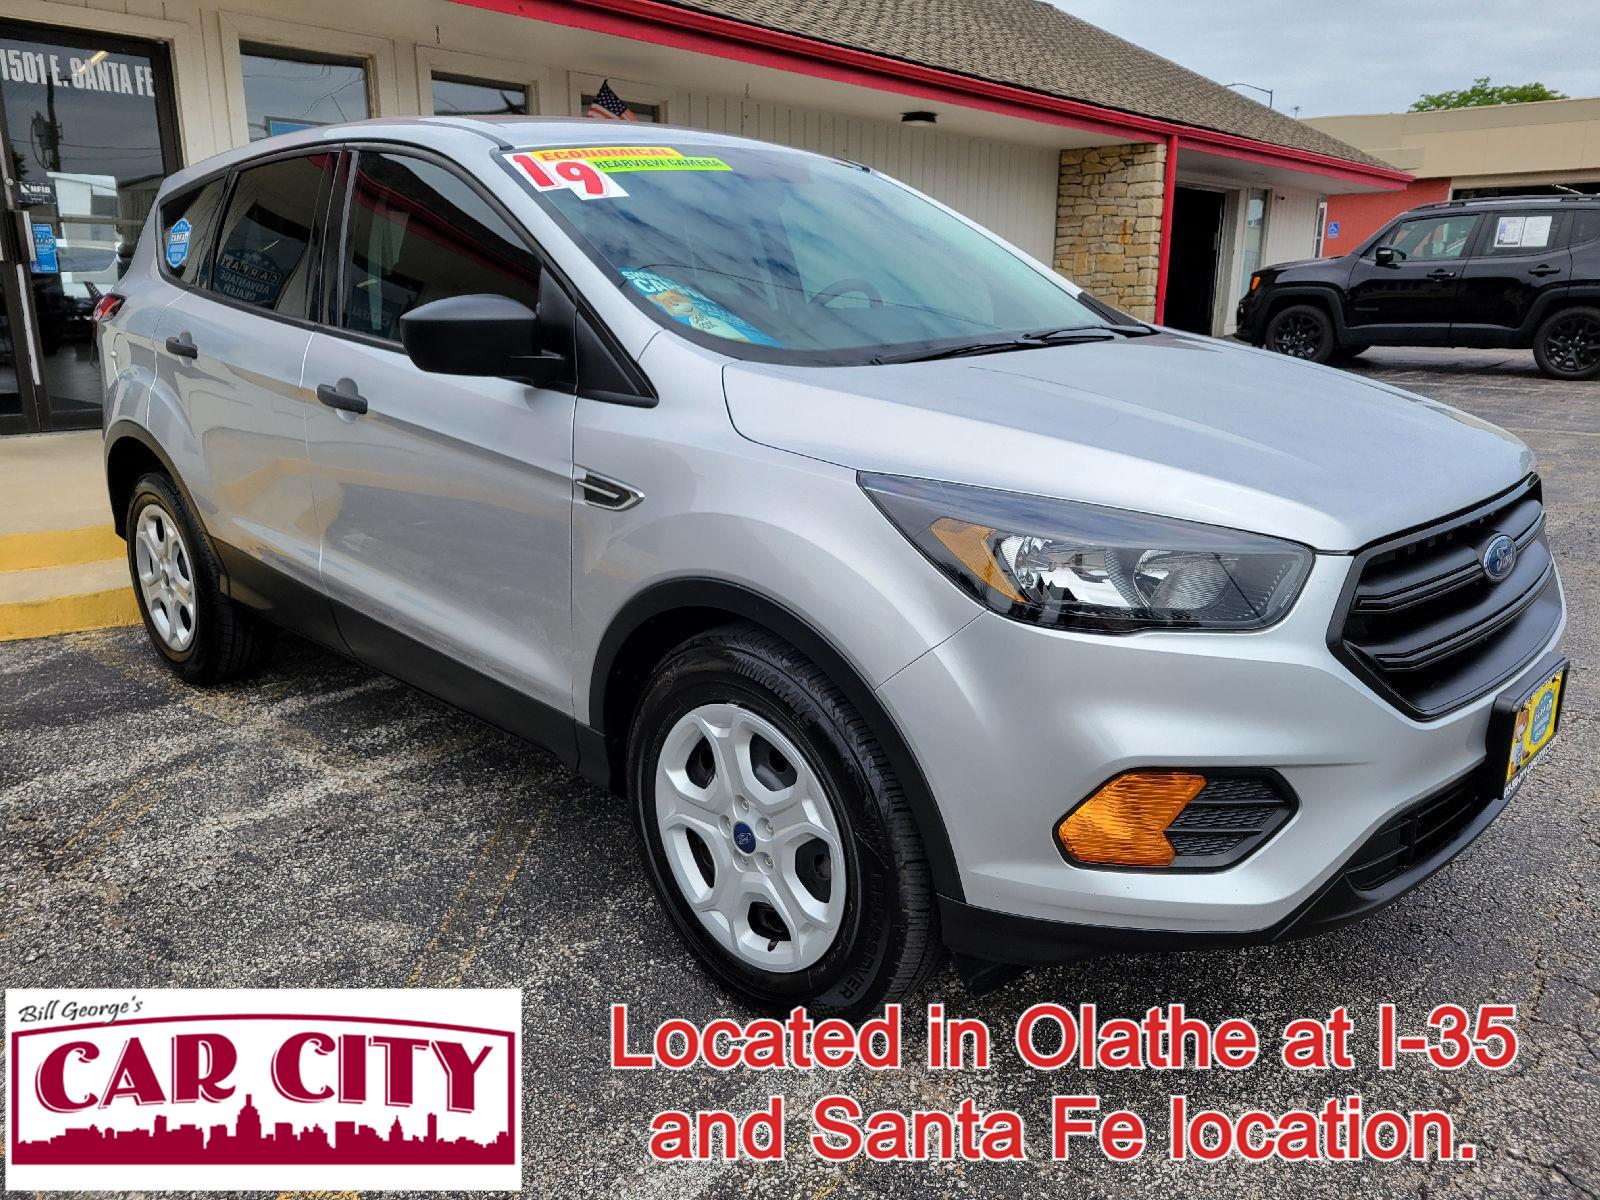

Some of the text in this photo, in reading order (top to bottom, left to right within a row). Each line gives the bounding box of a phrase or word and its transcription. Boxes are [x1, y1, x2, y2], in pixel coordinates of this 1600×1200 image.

[0, 48, 155, 97] 1501 E. SANTA FE
[541, 147, 674, 161] ECONOMICAL
[594, 159, 722, 170] REARVIEW CAMERA
[512, 154, 605, 196] 19
